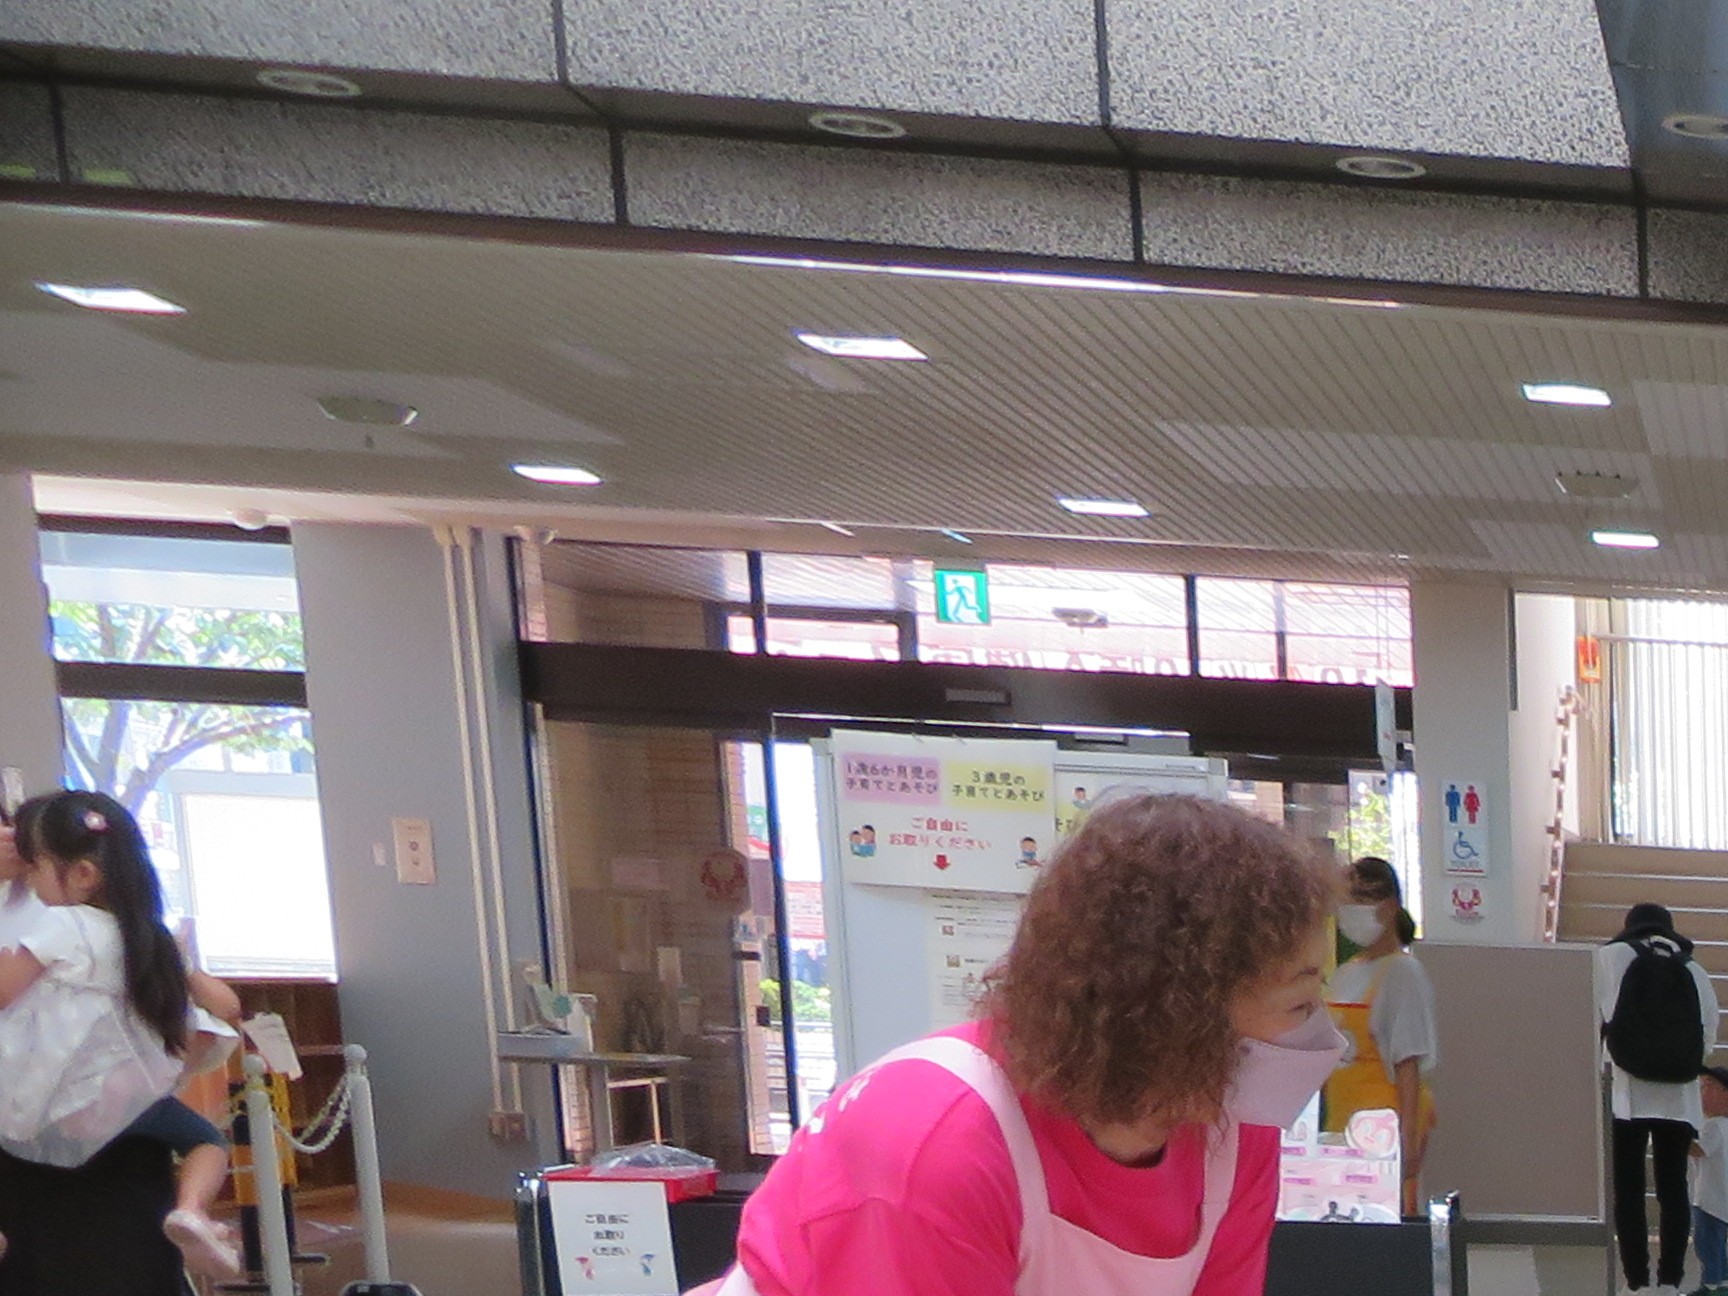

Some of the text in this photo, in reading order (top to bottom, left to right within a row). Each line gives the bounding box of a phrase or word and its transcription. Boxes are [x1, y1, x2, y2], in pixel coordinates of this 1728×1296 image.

[845, 776, 938, 796] 子育てとあそび
[971, 769, 1026, 787] 3歳児の
[951, 784, 1046, 802] 子育てとあそび
[910, 816, 969, 833] ご自由に
[888, 832, 993, 851] お取りください
